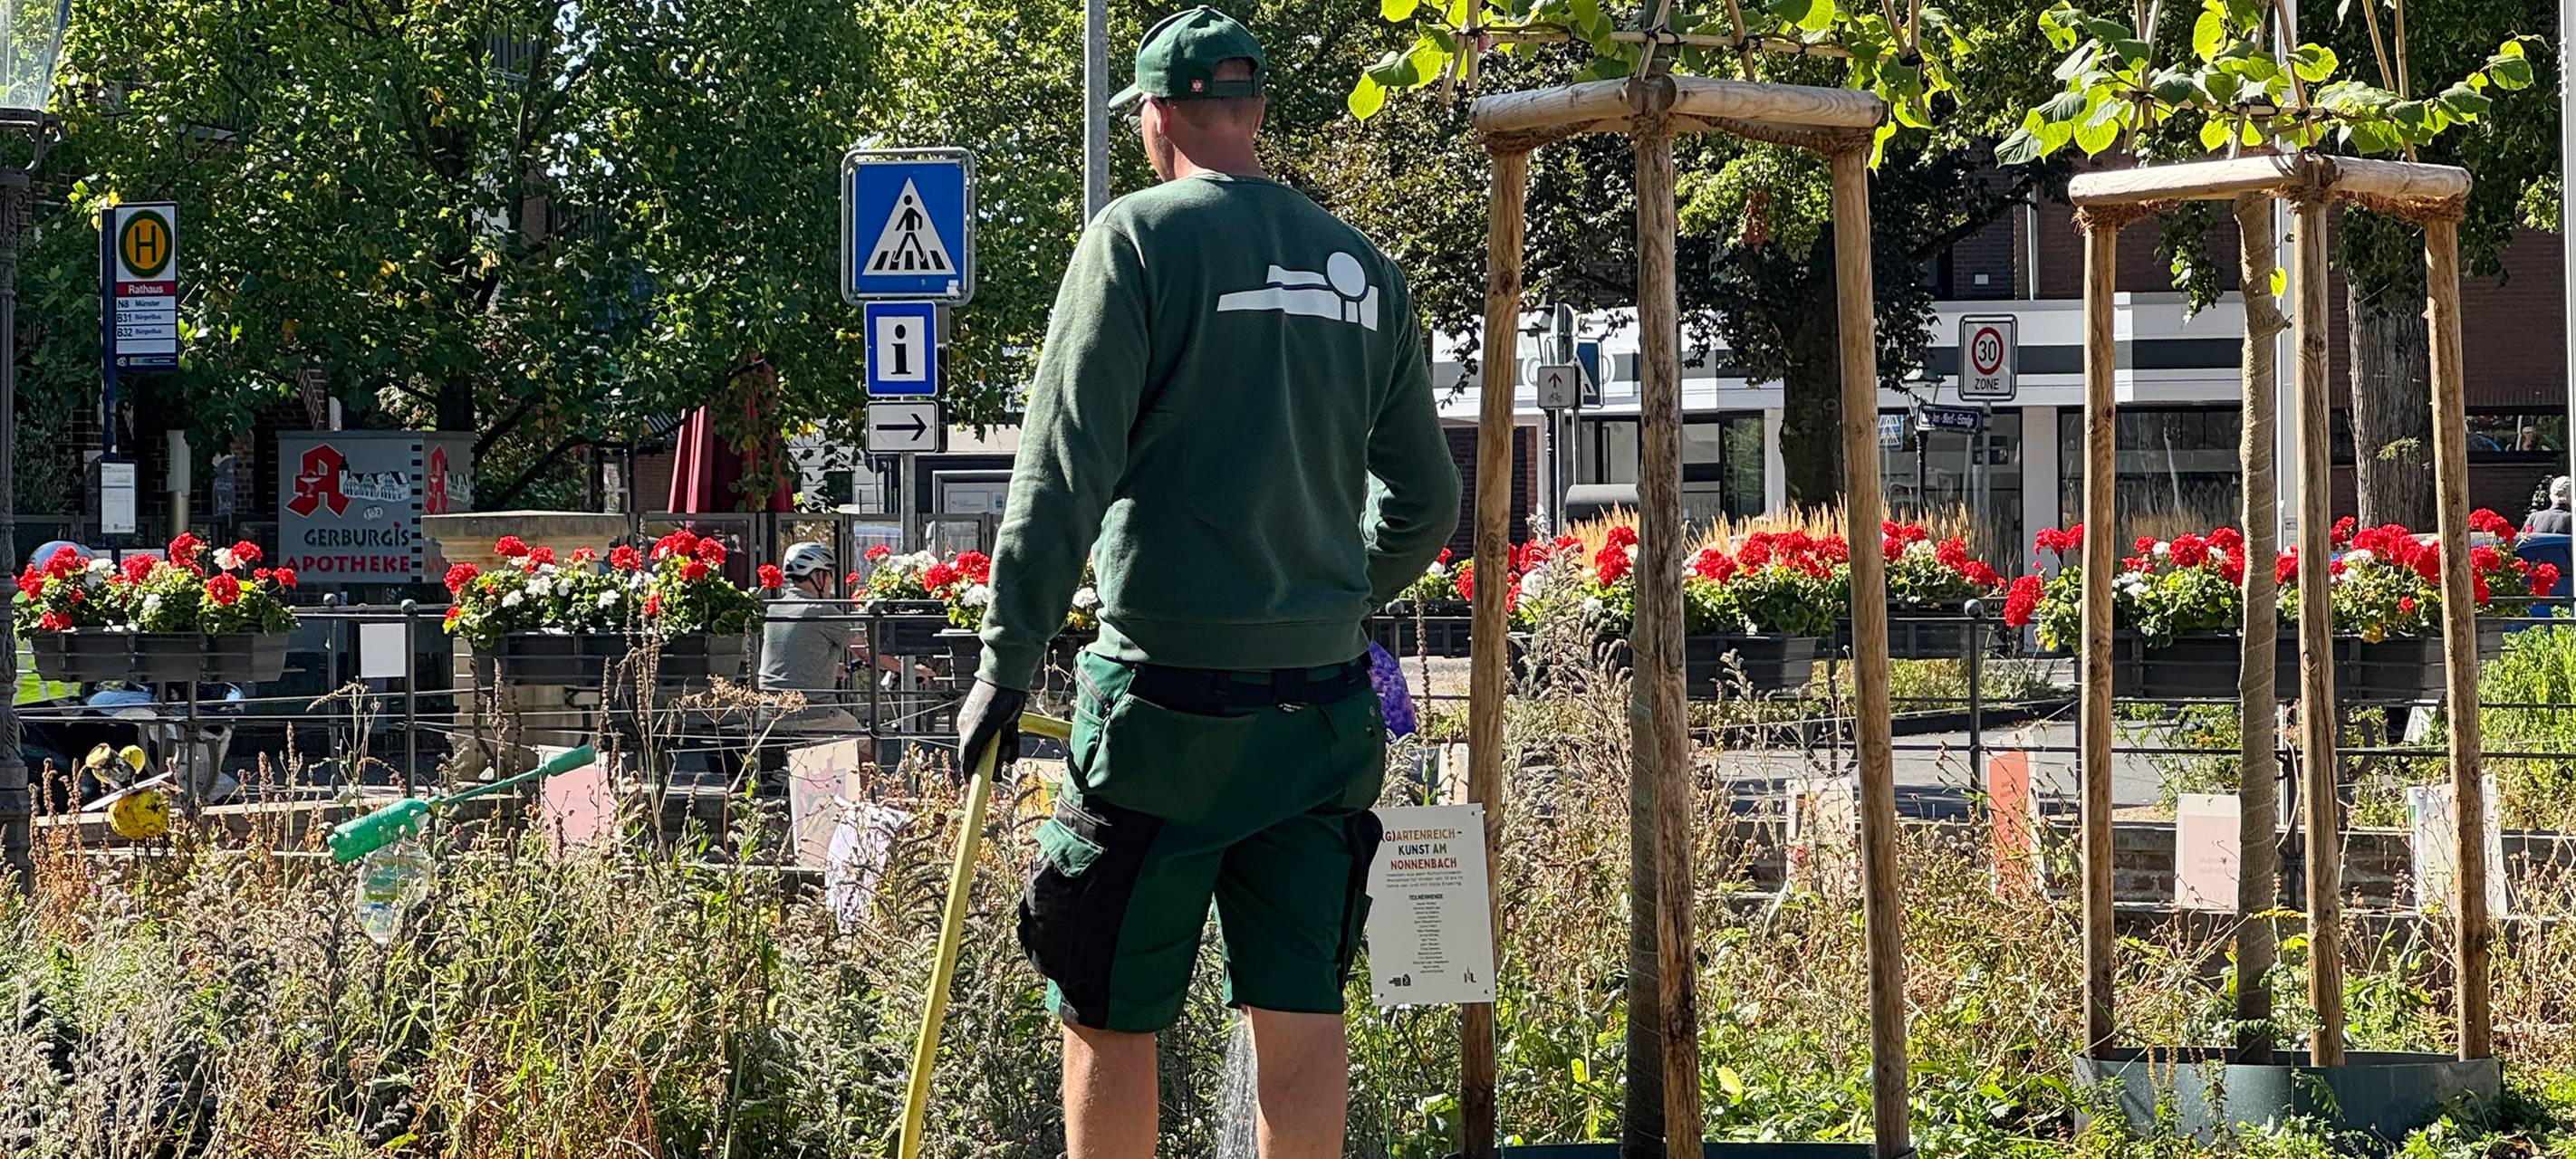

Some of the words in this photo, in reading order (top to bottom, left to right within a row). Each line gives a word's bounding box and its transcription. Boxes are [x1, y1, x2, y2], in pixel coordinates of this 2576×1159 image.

[135, 225, 157, 263] H
[128, 284, 164, 294] Rathaus
[117, 313, 132, 323] B31
[117, 327, 133, 337] B32
[1978, 340, 1997, 362] 30
[1975, 378, 2000, 390] ZONE
[284, 555, 410, 573] APOTHEKE
[1398, 844, 1430, 856] KUNST
[1433, 843, 1447, 854] AM
[1390, 857, 1457, 870] NONNENBACH
